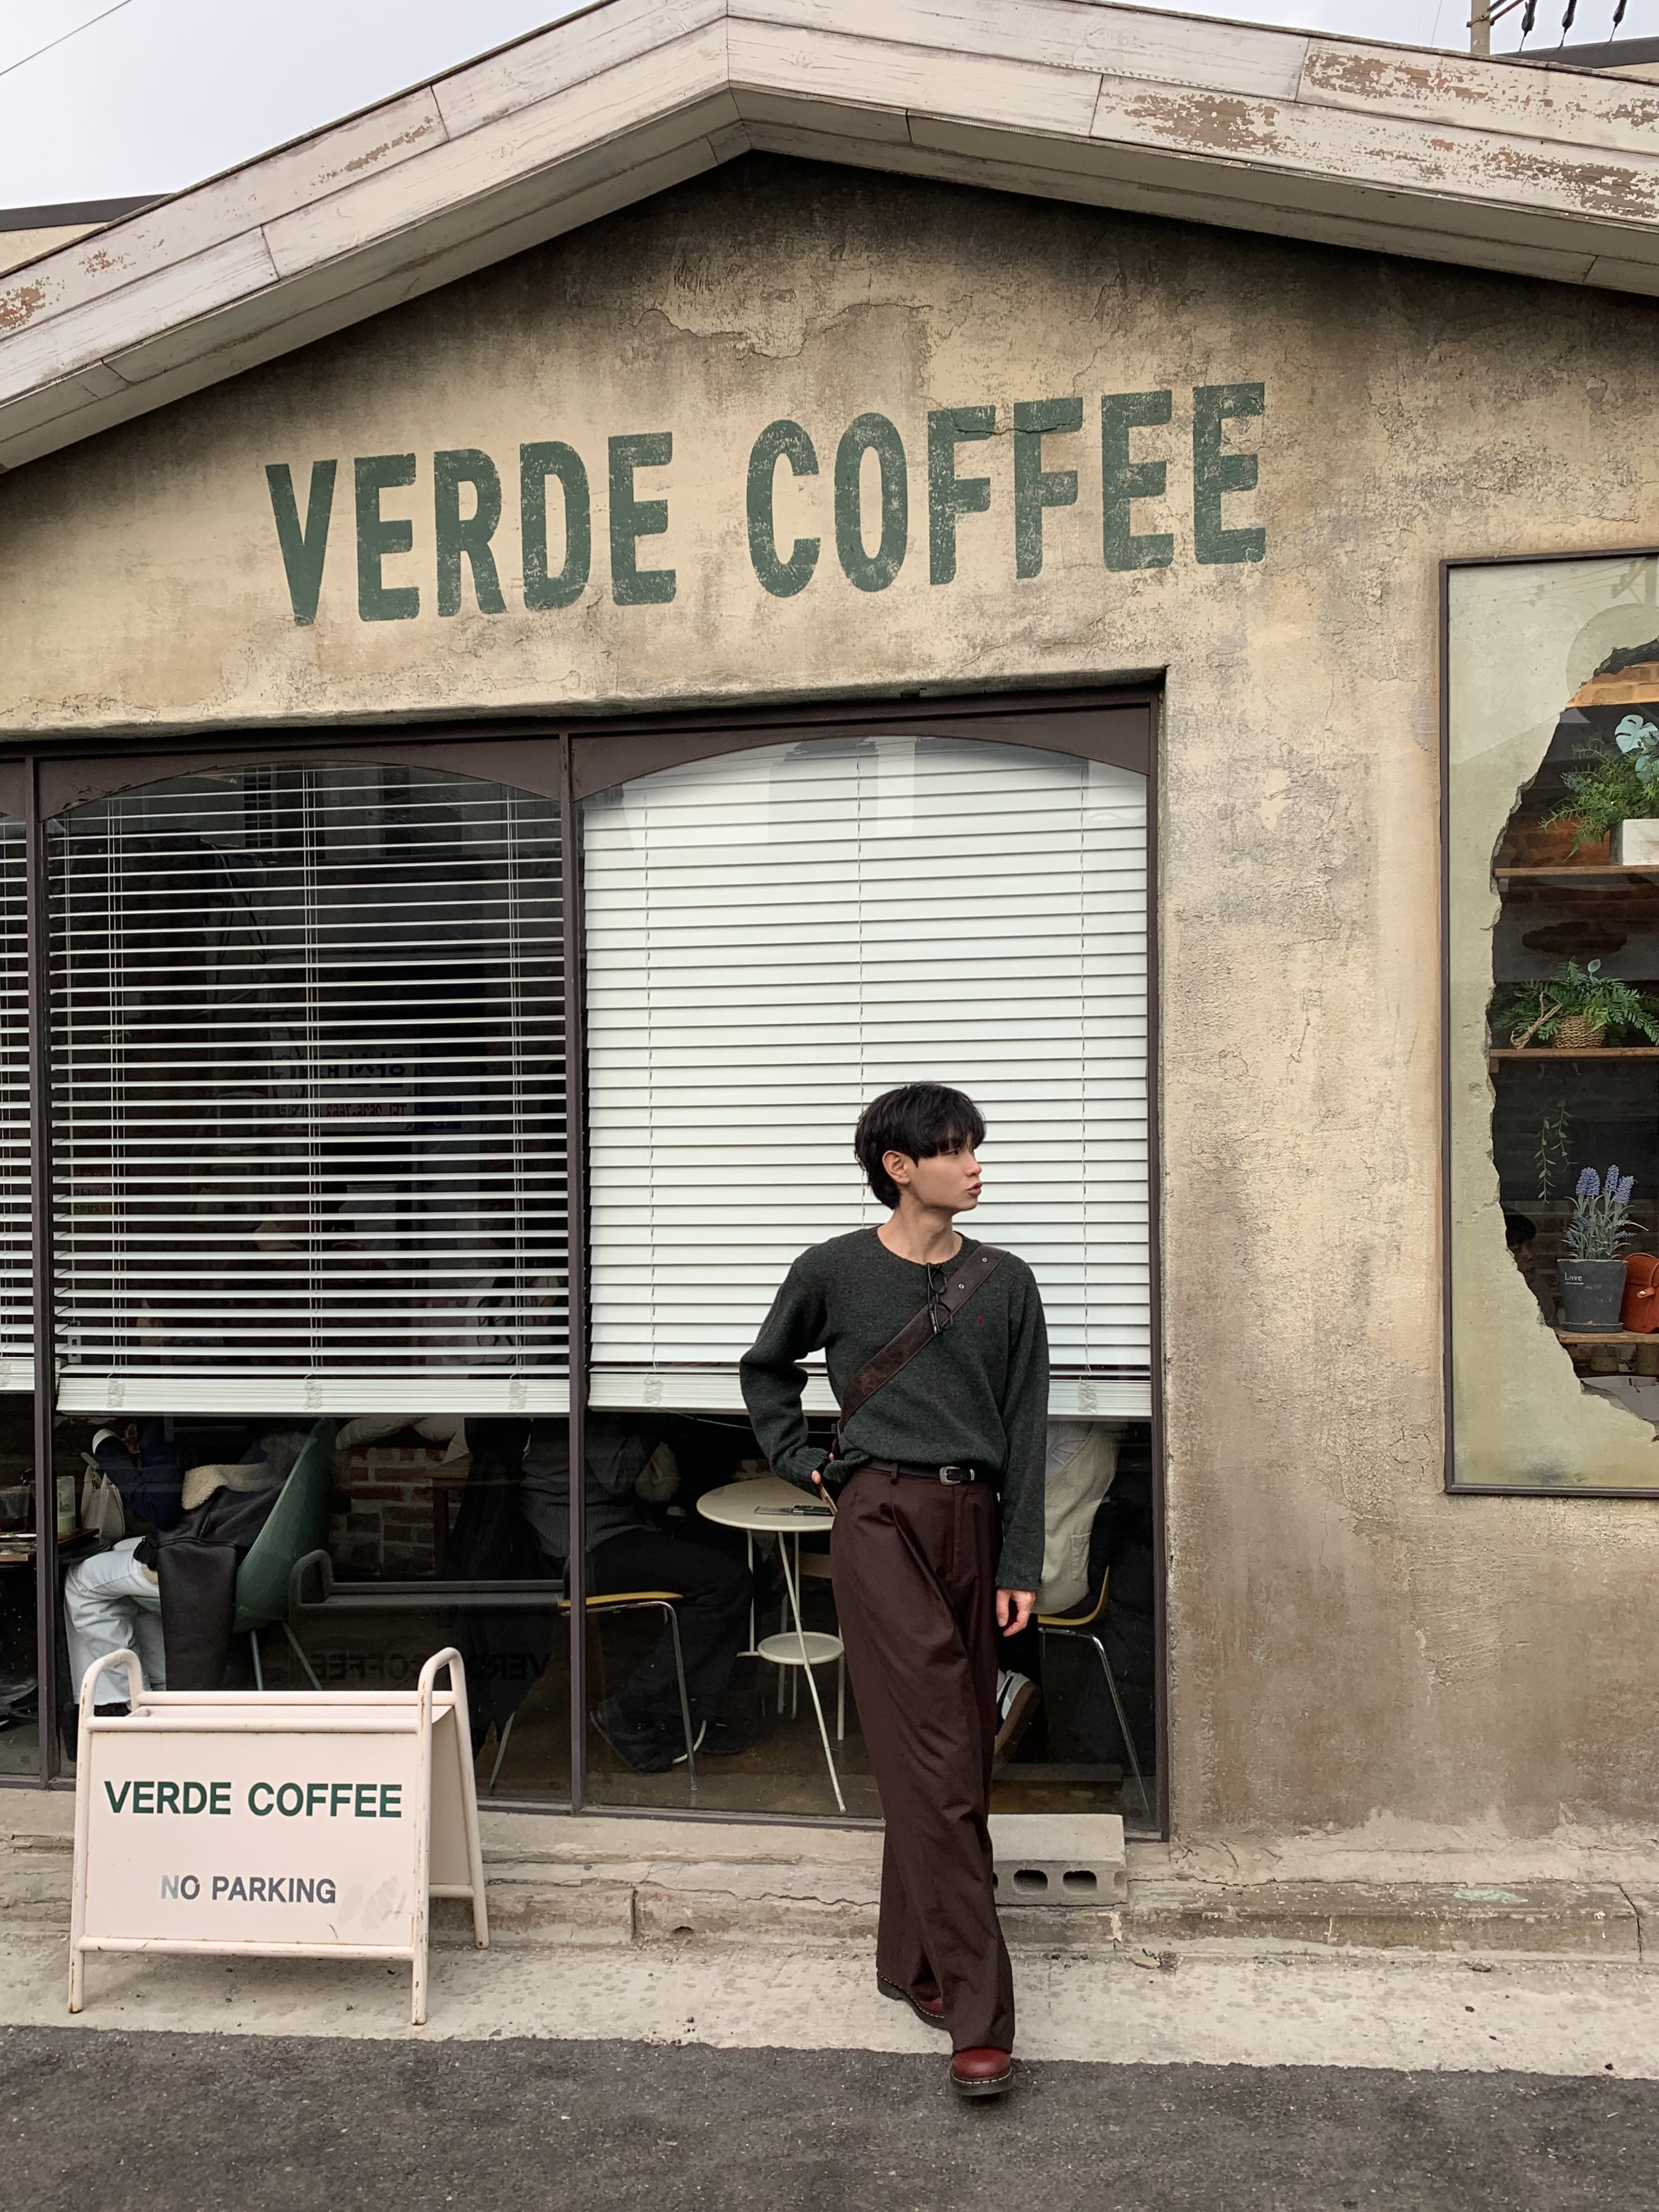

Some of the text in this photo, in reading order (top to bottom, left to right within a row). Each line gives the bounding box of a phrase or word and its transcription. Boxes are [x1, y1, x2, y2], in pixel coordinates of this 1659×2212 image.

[266, 383, 1265, 626] VERDE COFFEE
[1564, 1272, 1583, 1281] Love
[104, 1781, 402, 1818] VERDE COFFEE
[161, 1874, 336, 1904] NO PARKING
